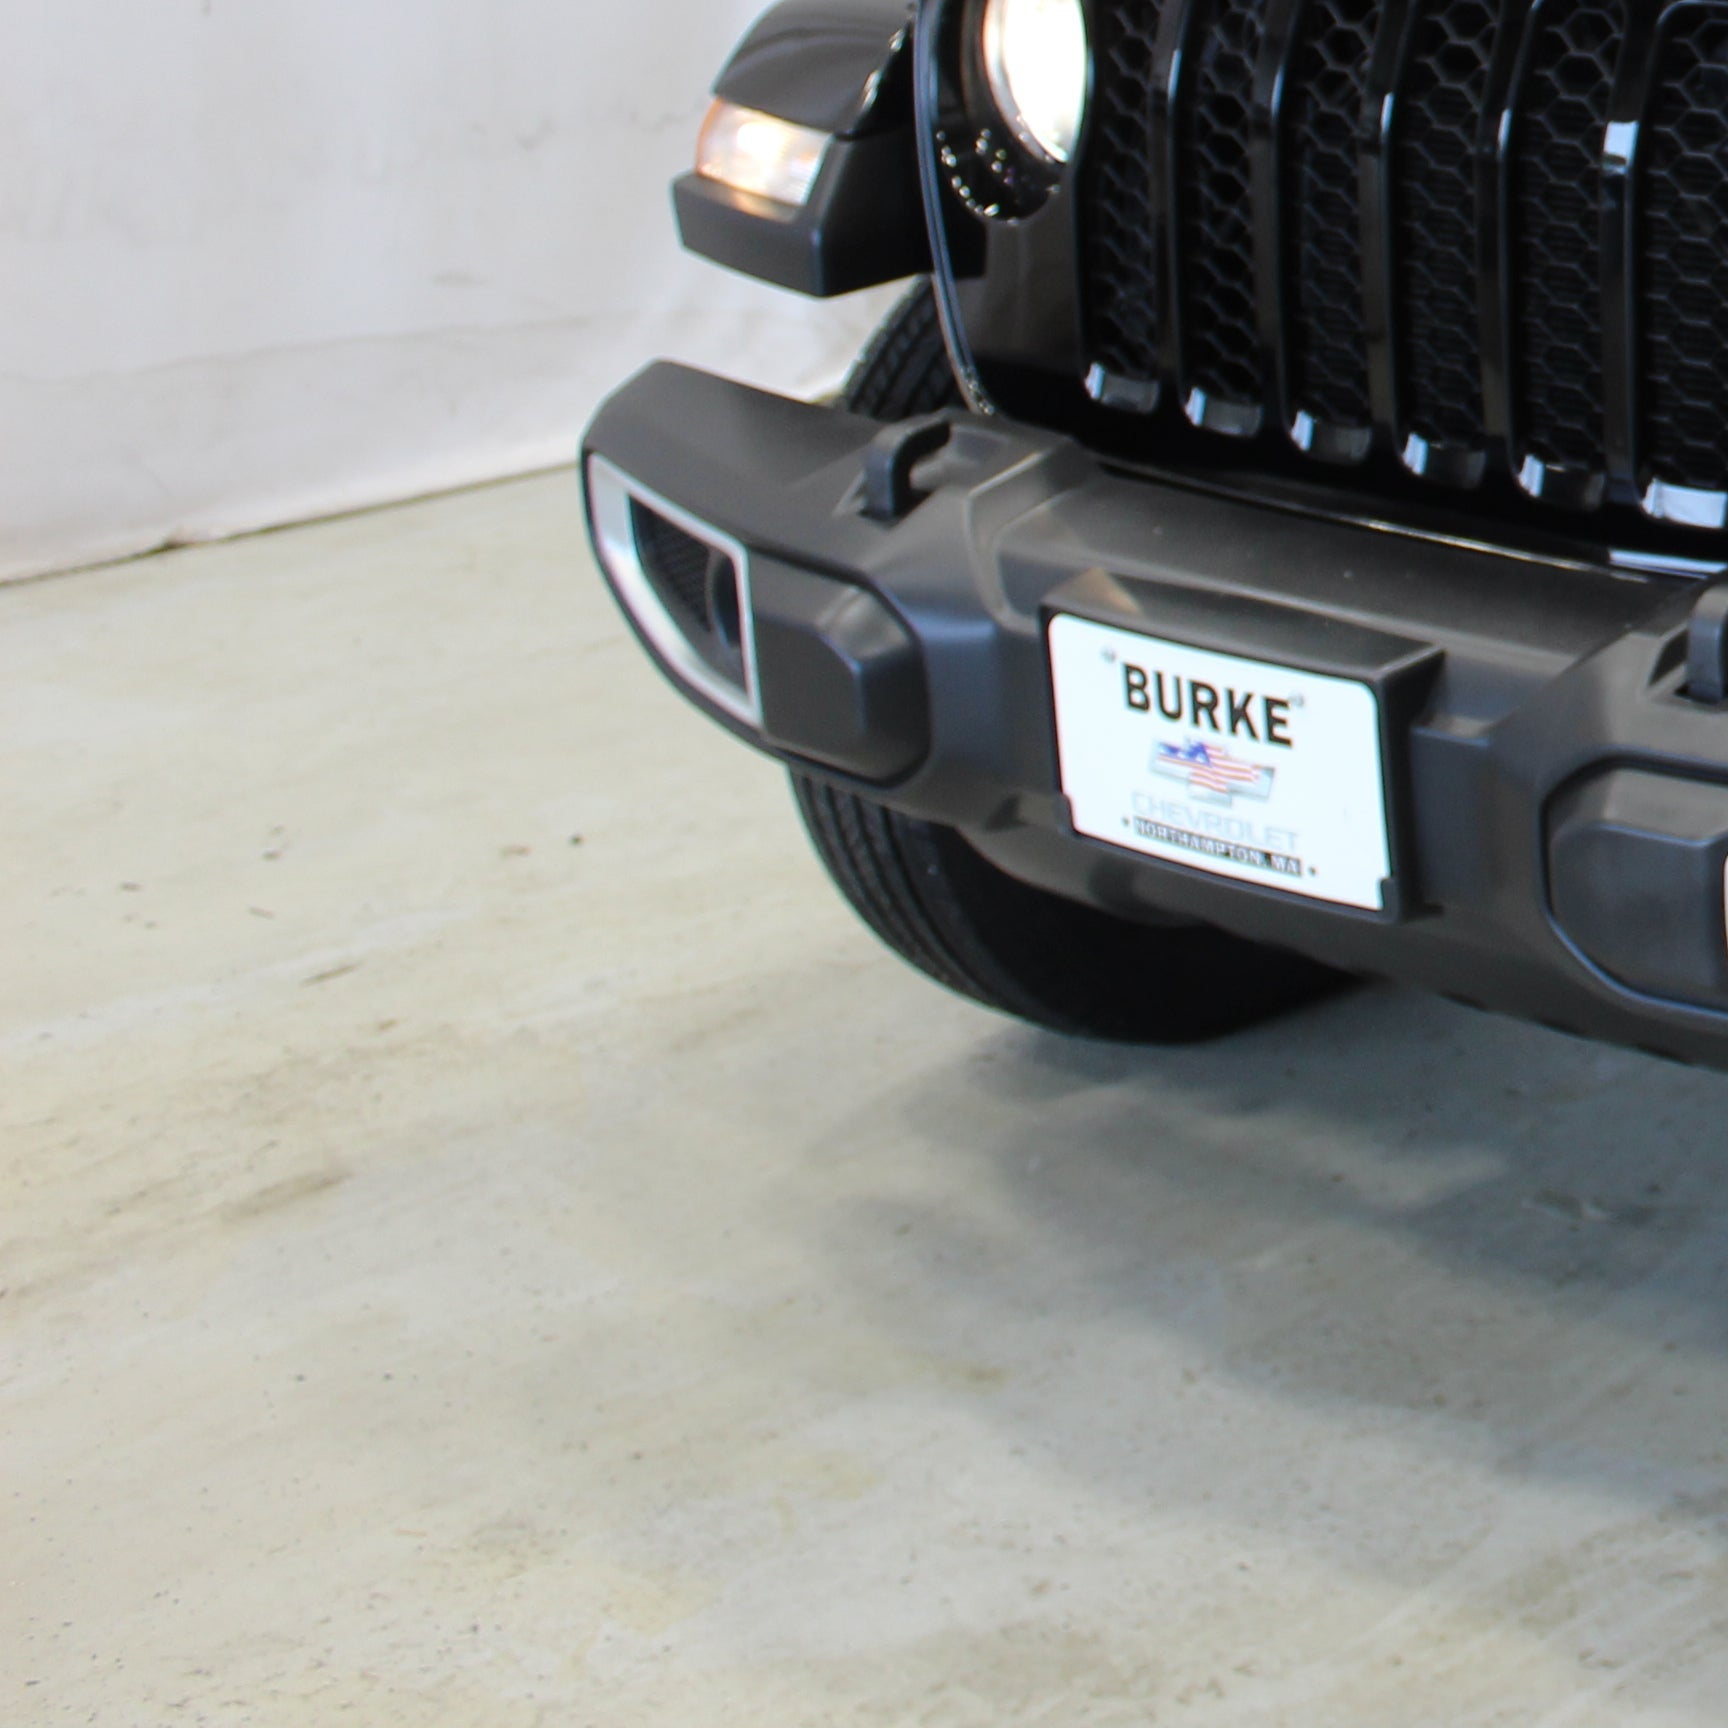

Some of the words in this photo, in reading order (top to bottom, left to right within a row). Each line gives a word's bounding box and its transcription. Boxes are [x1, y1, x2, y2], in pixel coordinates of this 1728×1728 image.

[1123, 663, 1292, 747] BURKE
[1131, 791, 1298, 852] CHEVROLET
[1270, 853, 1300, 876] MA
